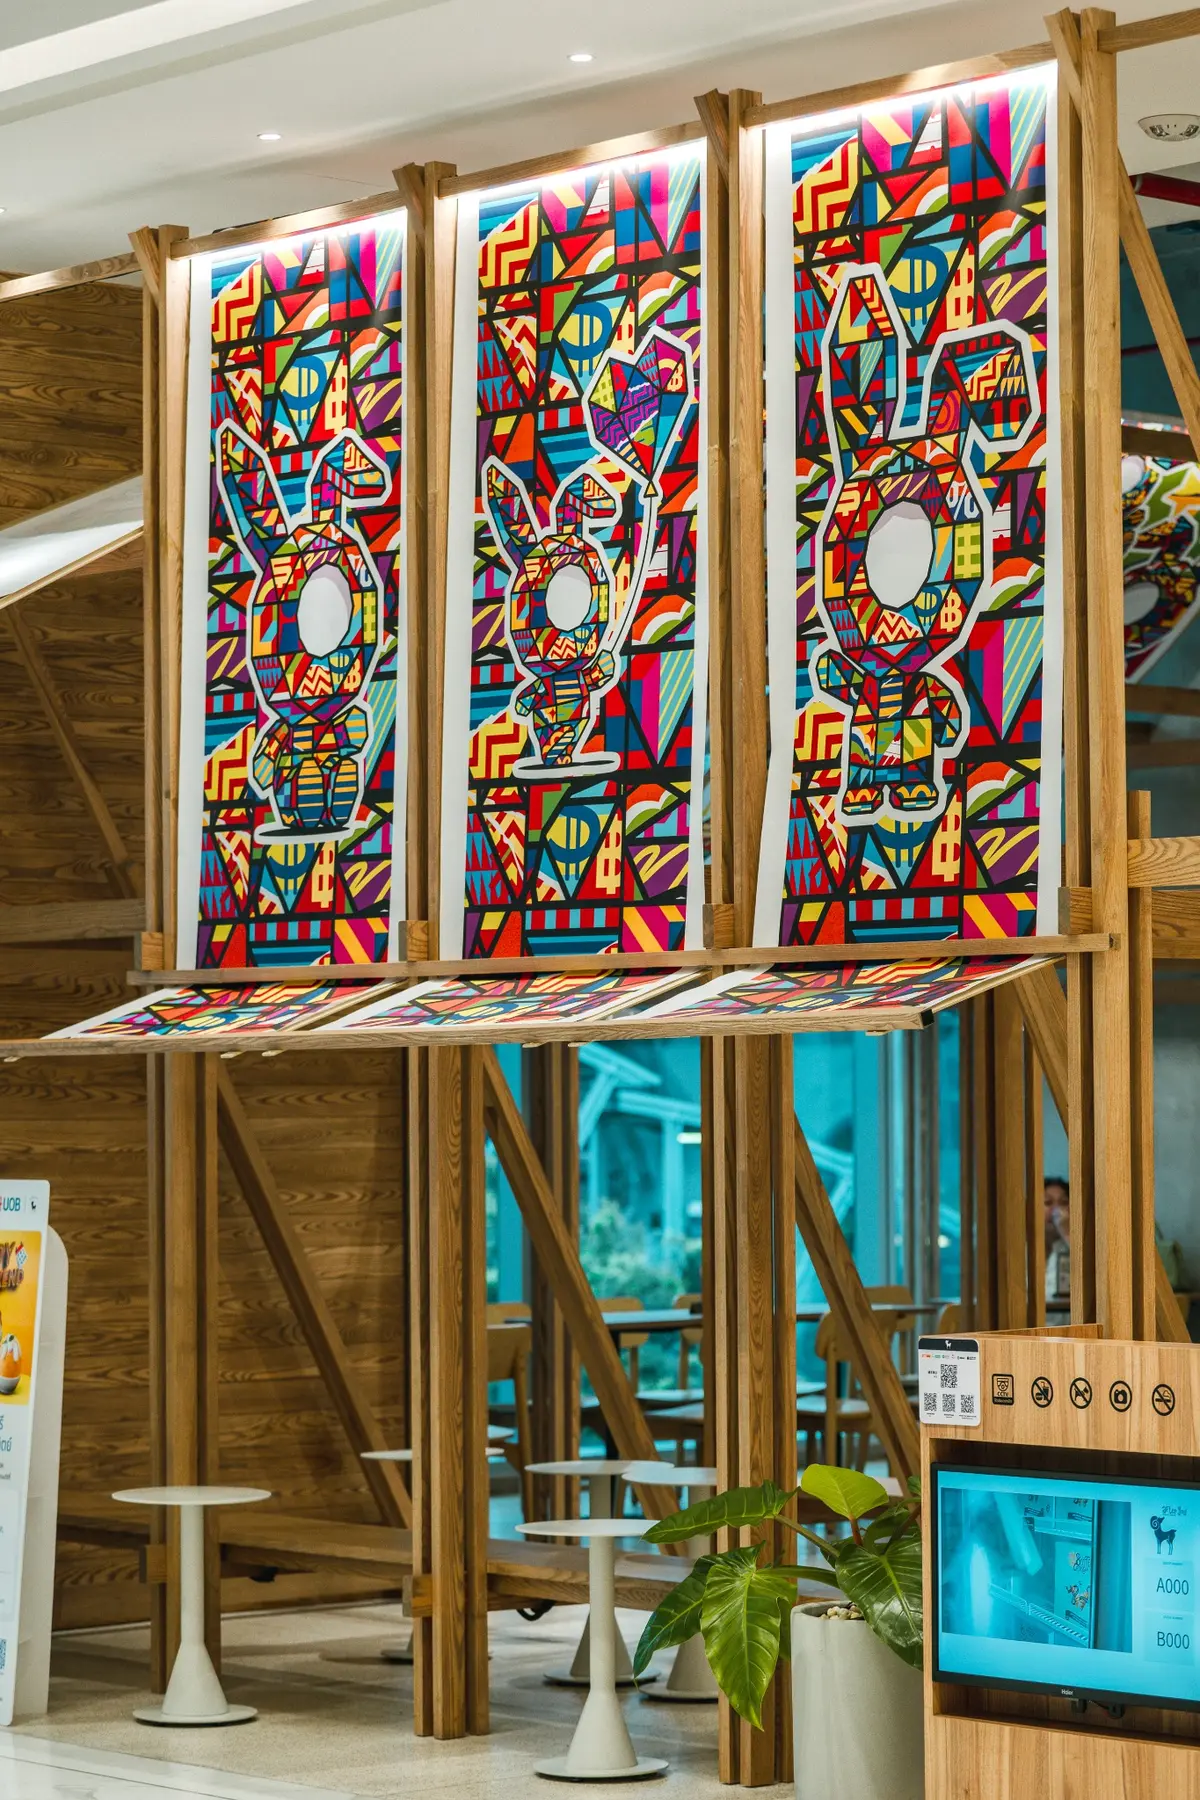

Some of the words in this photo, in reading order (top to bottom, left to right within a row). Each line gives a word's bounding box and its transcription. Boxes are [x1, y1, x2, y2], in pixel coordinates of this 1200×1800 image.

[3, 1197, 21, 1212] UOB
[1156, 1577, 1189, 1596] A000
[1157, 1631, 1190, 1650] B000
[1061, 1688, 1074, 1696] Haier
